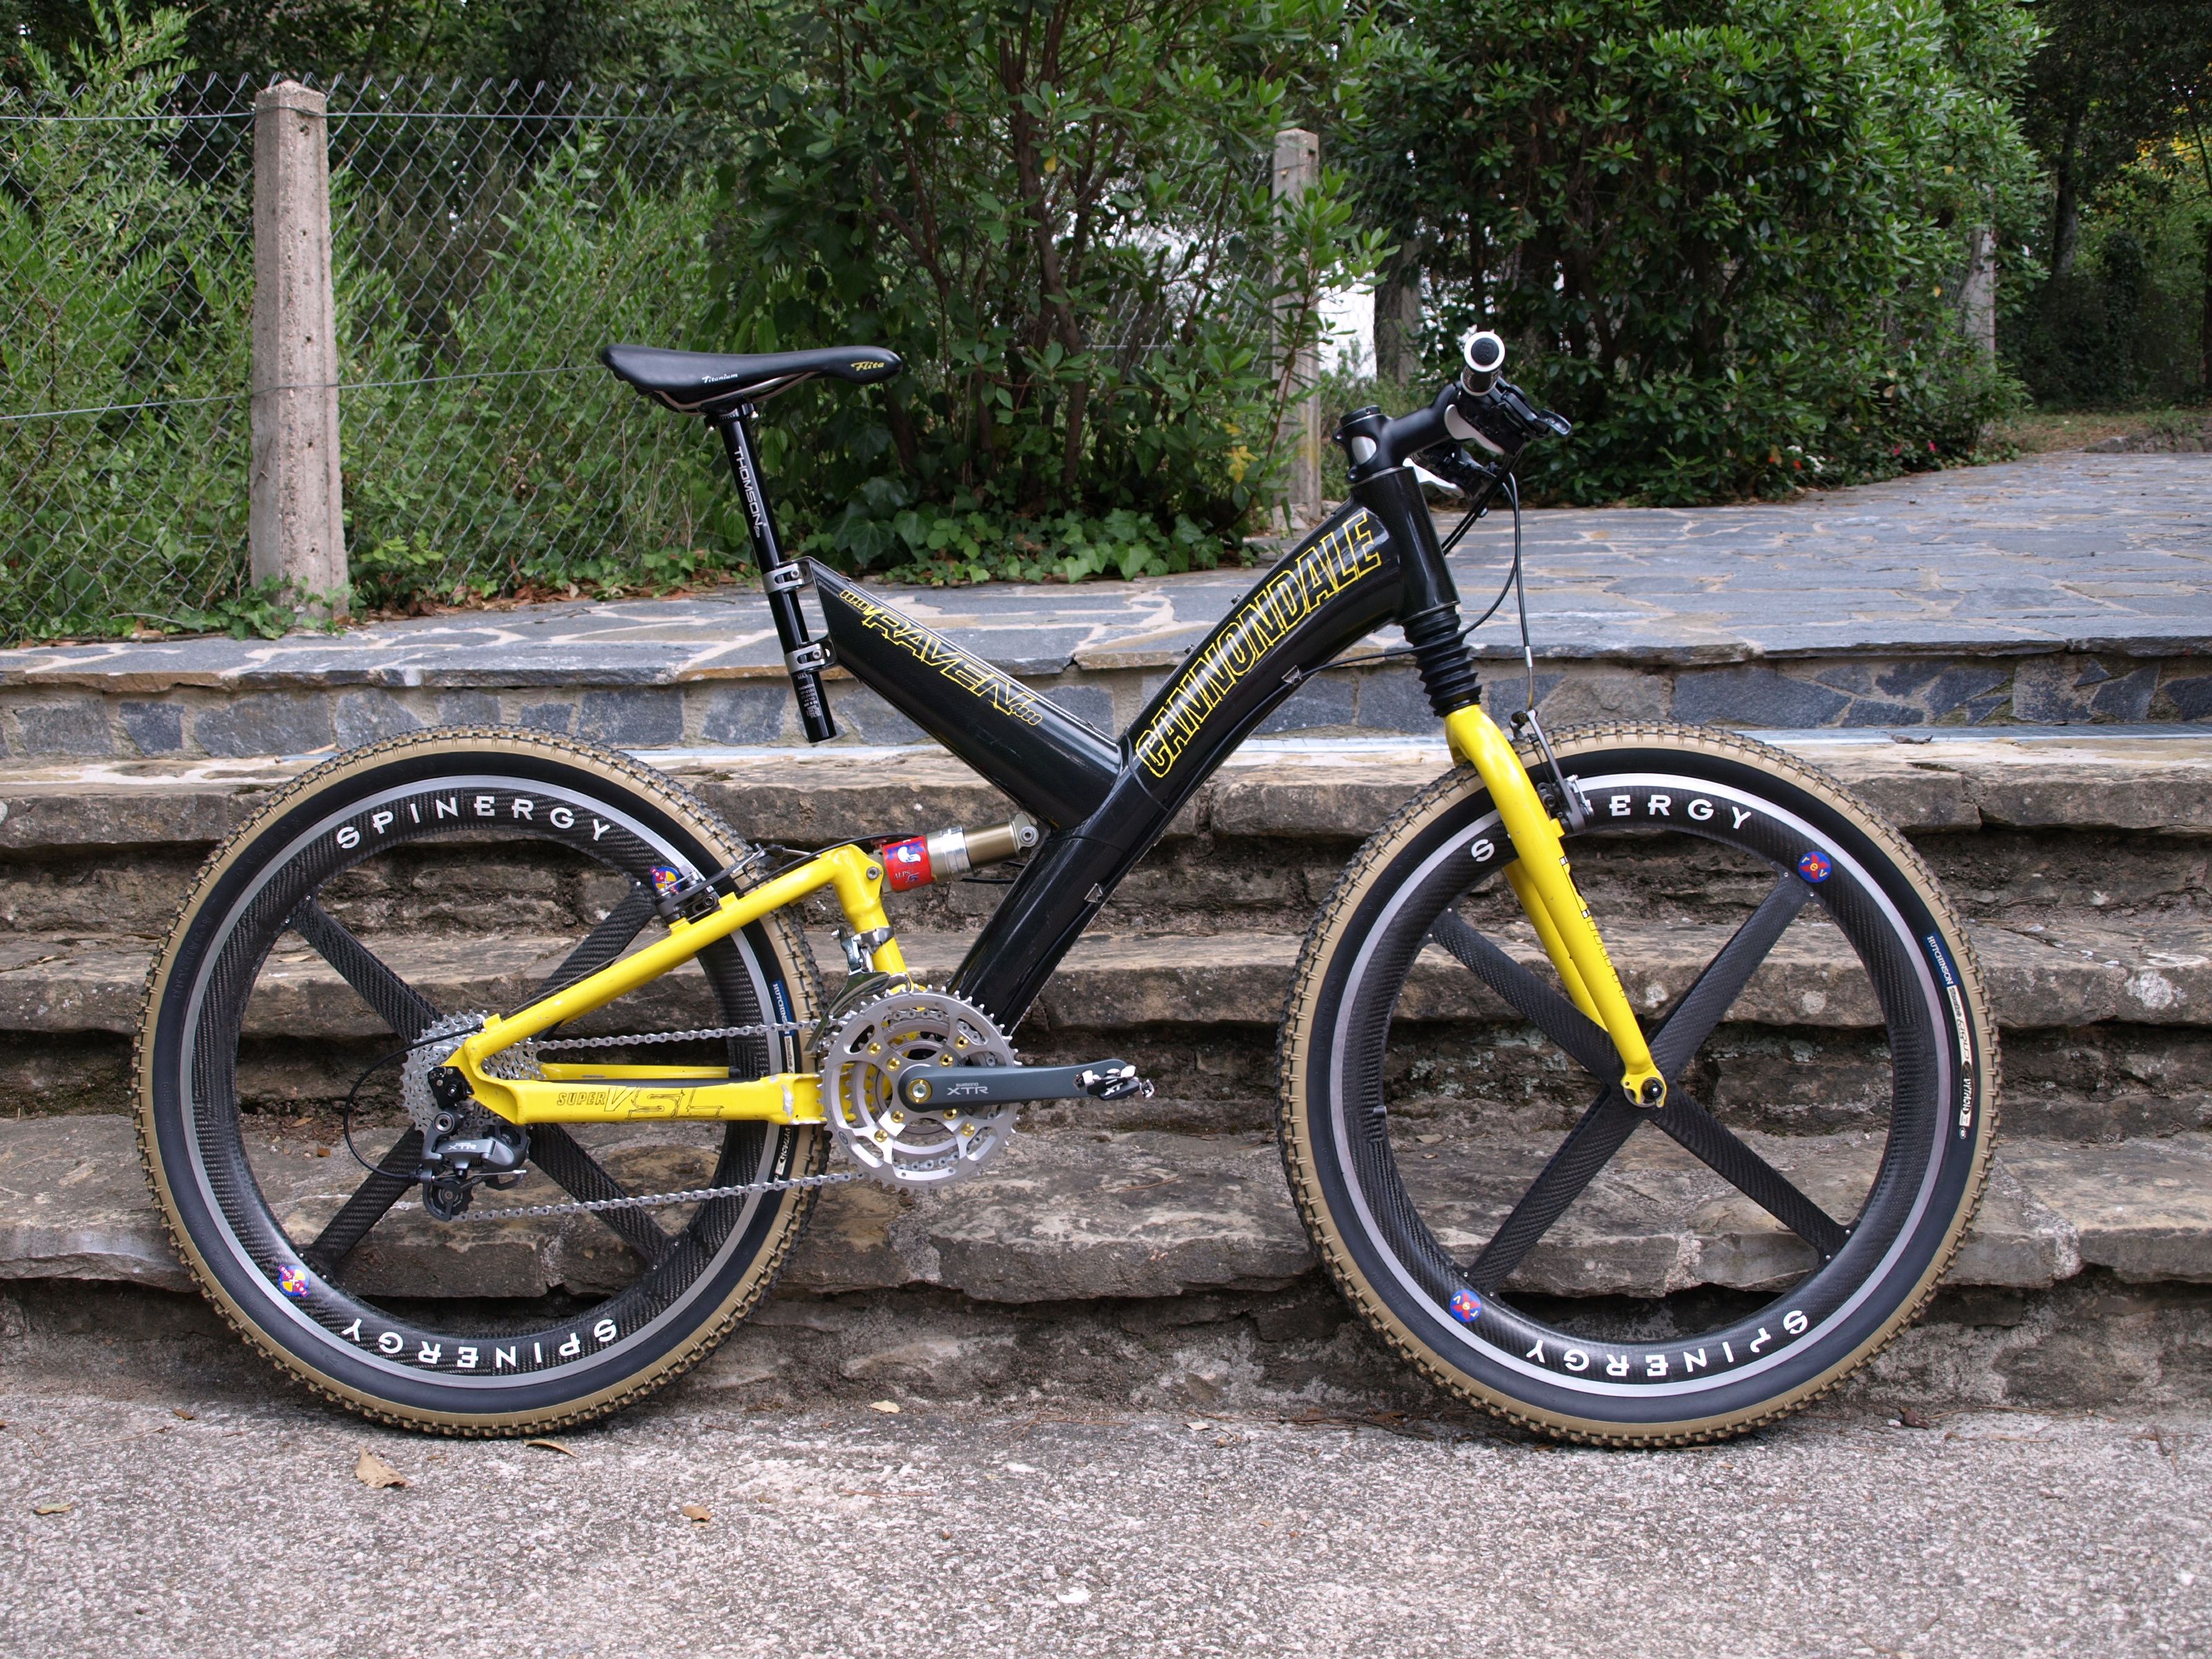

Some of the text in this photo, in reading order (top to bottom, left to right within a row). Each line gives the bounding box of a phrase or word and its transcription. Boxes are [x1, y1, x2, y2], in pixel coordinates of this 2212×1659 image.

[702, 373, 738, 384] Titanium
[851, 361, 884, 372] Flite
[734, 446, 762, 527] THOMSON
[862, 607, 1038, 716] RAVEN
[1136, 510, 1381, 778] CANNONDALE
[337, 795, 610, 849] SPINERGY
[1471, 794, 1752, 863] SERGY
[1927, 935, 1954, 986] HUTCHINSON
[556, 1091, 606, 1106] SUPER
[947, 1087, 988, 1095] XTR
[1963, 1078, 1971, 1114] PYTHON
[342, 1318, 617, 1370] SPINERGY
